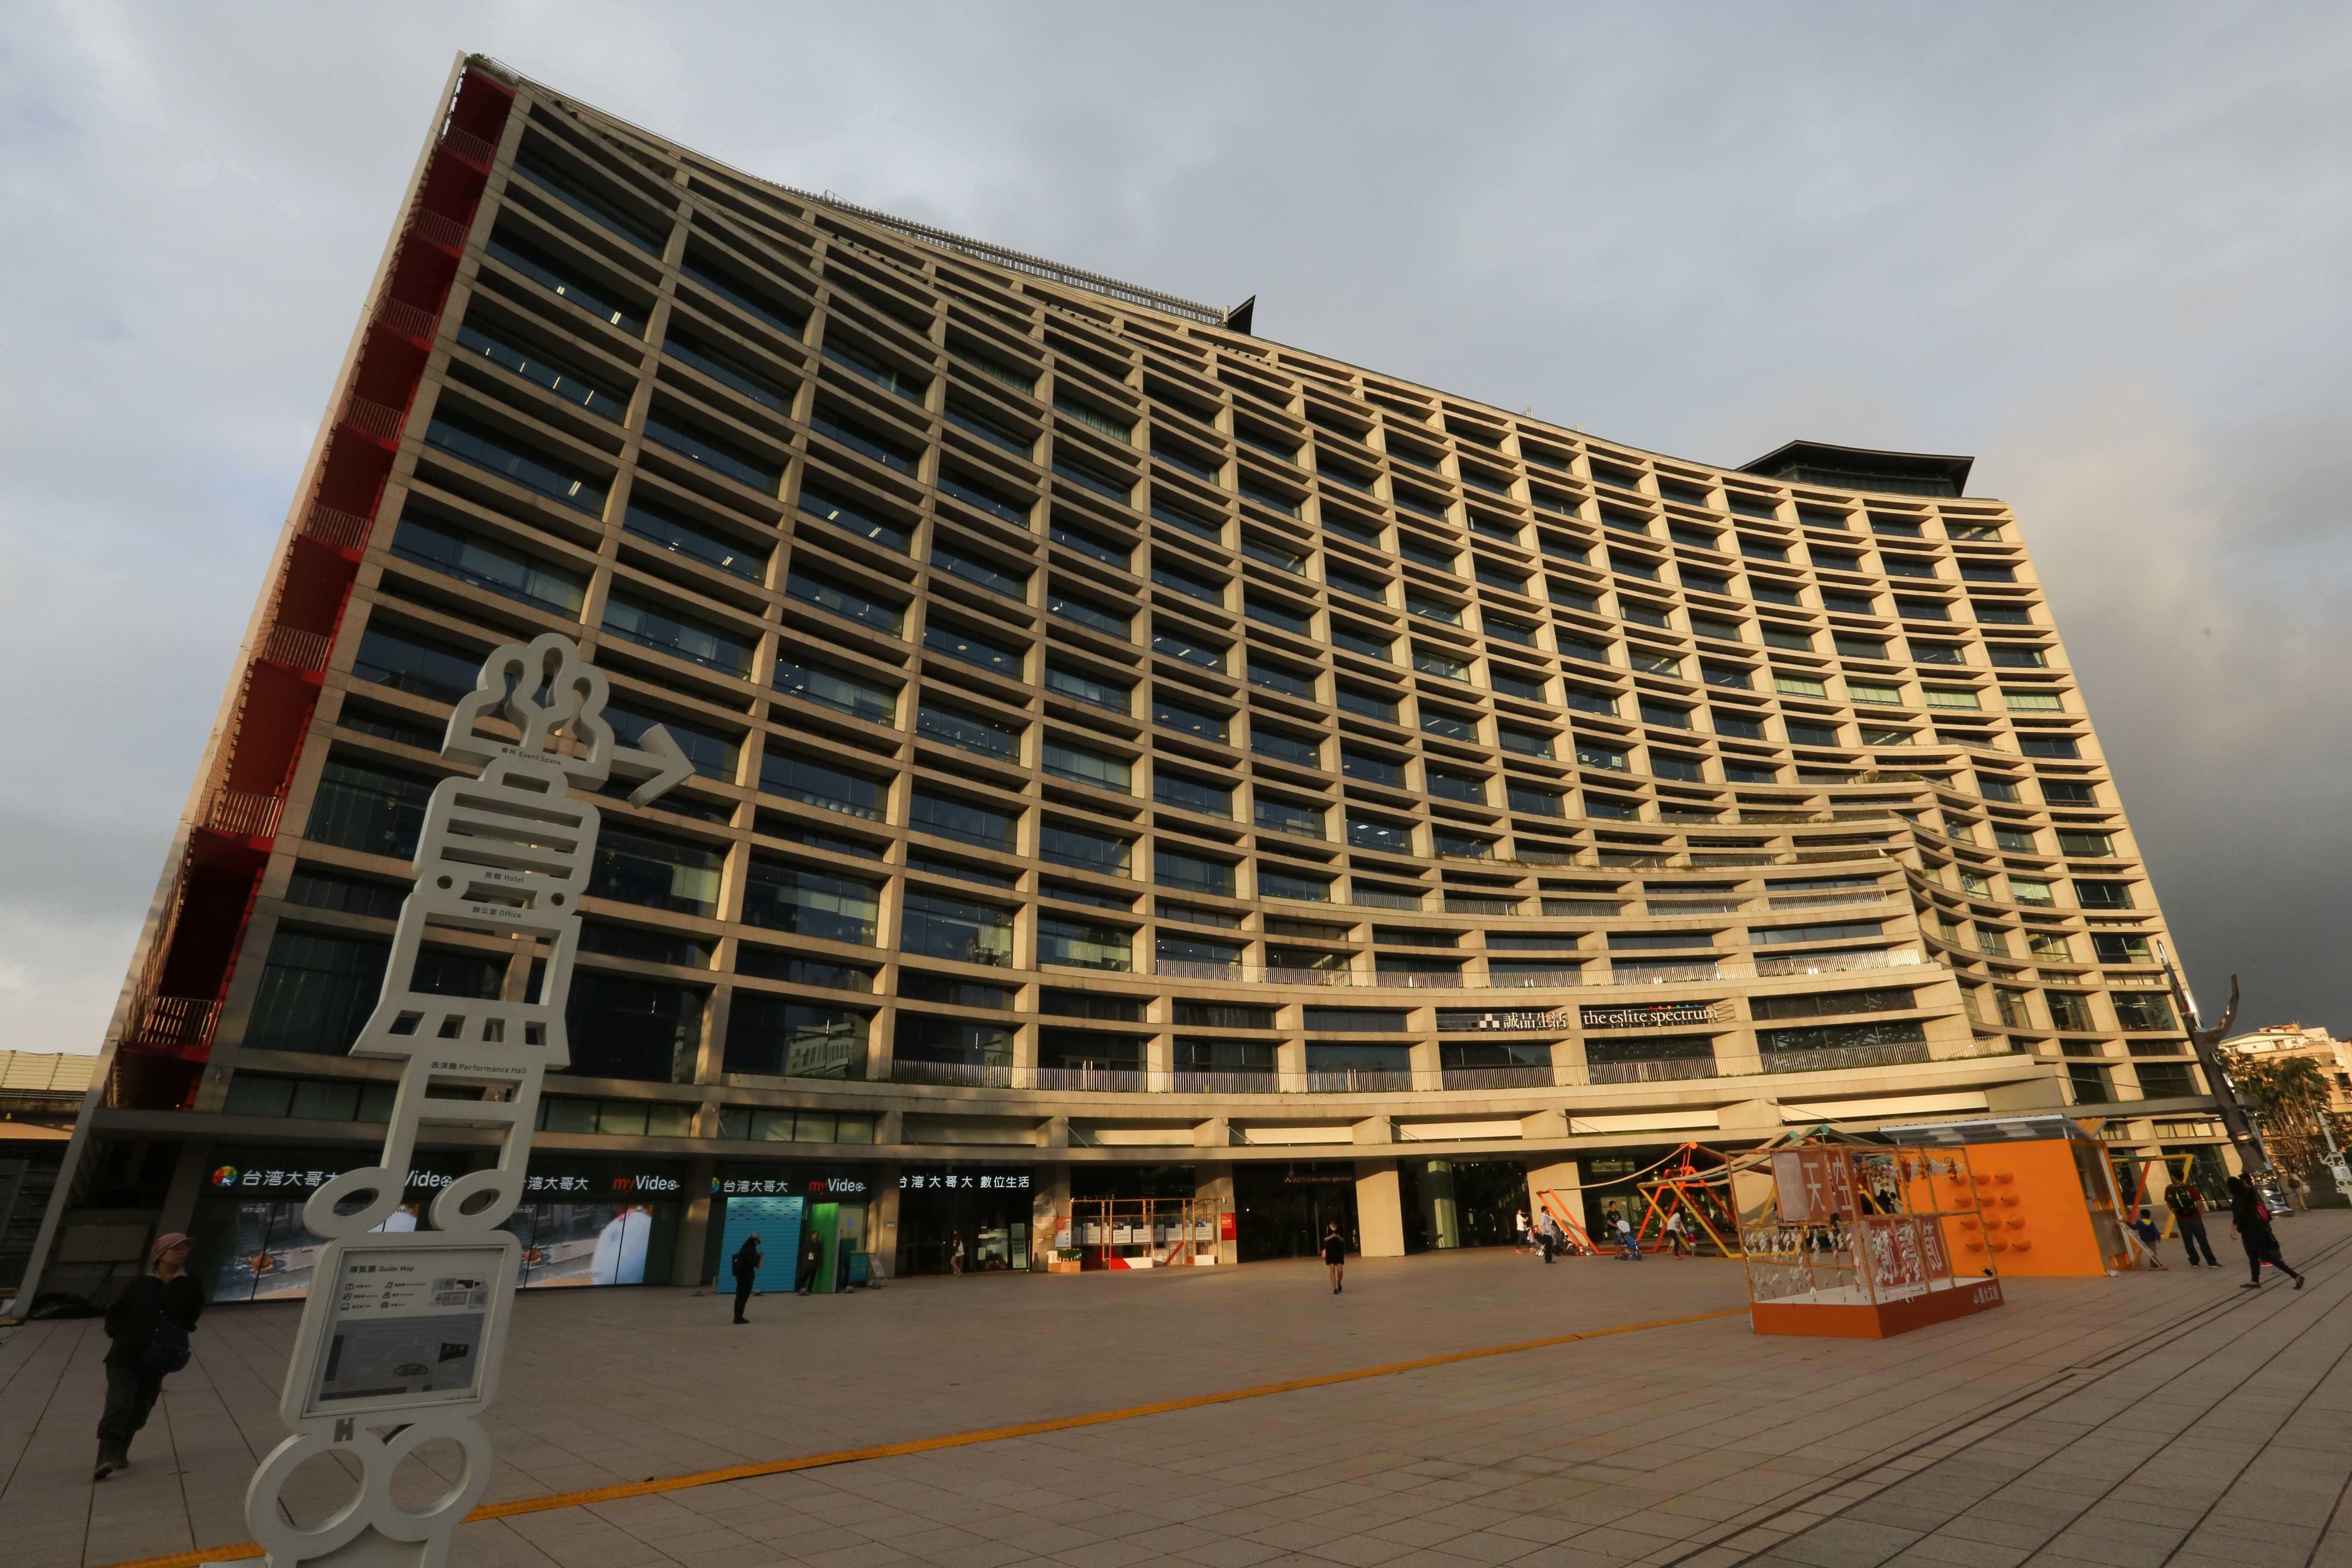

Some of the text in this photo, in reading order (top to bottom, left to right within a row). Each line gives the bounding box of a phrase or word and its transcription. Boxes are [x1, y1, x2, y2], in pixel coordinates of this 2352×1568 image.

[519, 752, 539, 760] Event
[540, 756, 561, 765] Space
[484, 872, 524, 883] 旅館 Hotel
[472, 906, 522, 918] 辦公室 Office
[1503, 1009, 1718, 1030] 誠品生活 the eslite spectrum
[431, 1061, 457, 1070] 表演廳
[459, 1063, 509, 1073] Performance
[525, 1176, 588, 1190] 湾大哥大
[980, 1176, 1029, 1188] 數位生活
